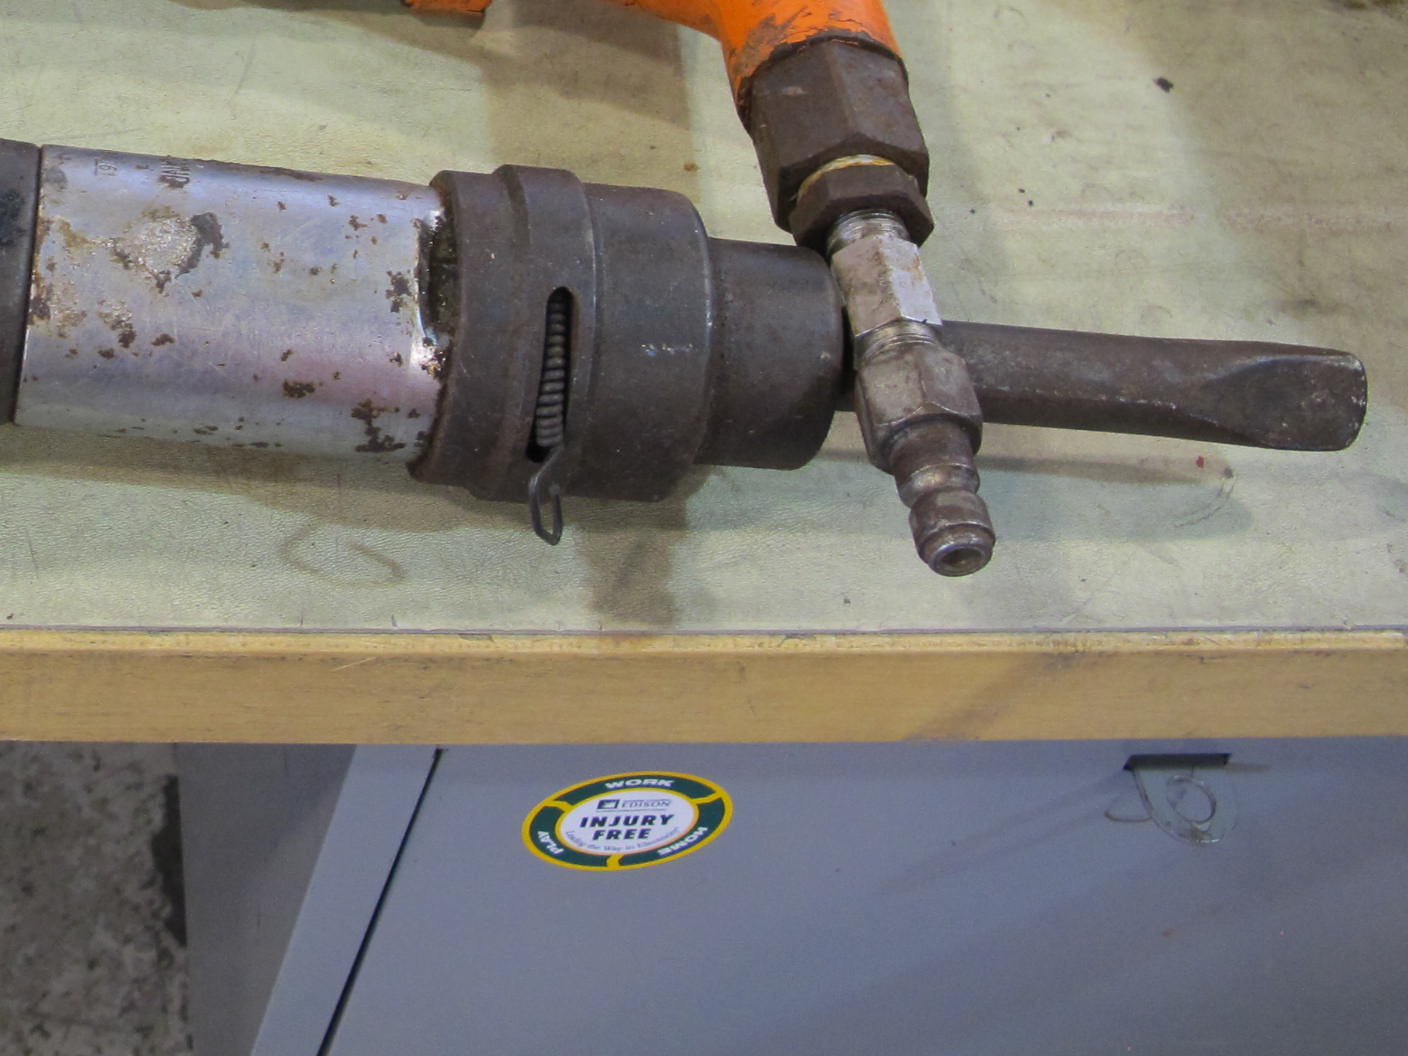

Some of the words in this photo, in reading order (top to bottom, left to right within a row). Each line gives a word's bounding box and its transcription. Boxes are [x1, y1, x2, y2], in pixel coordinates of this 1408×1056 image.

[604, 778, 674, 789] WORK
[621, 799, 672, 809] EDISON
[579, 814, 675, 828] INJURY
[593, 828, 652, 841] FREE
[537, 831, 564, 855] PLAY
[657, 827, 708, 856] HOME
